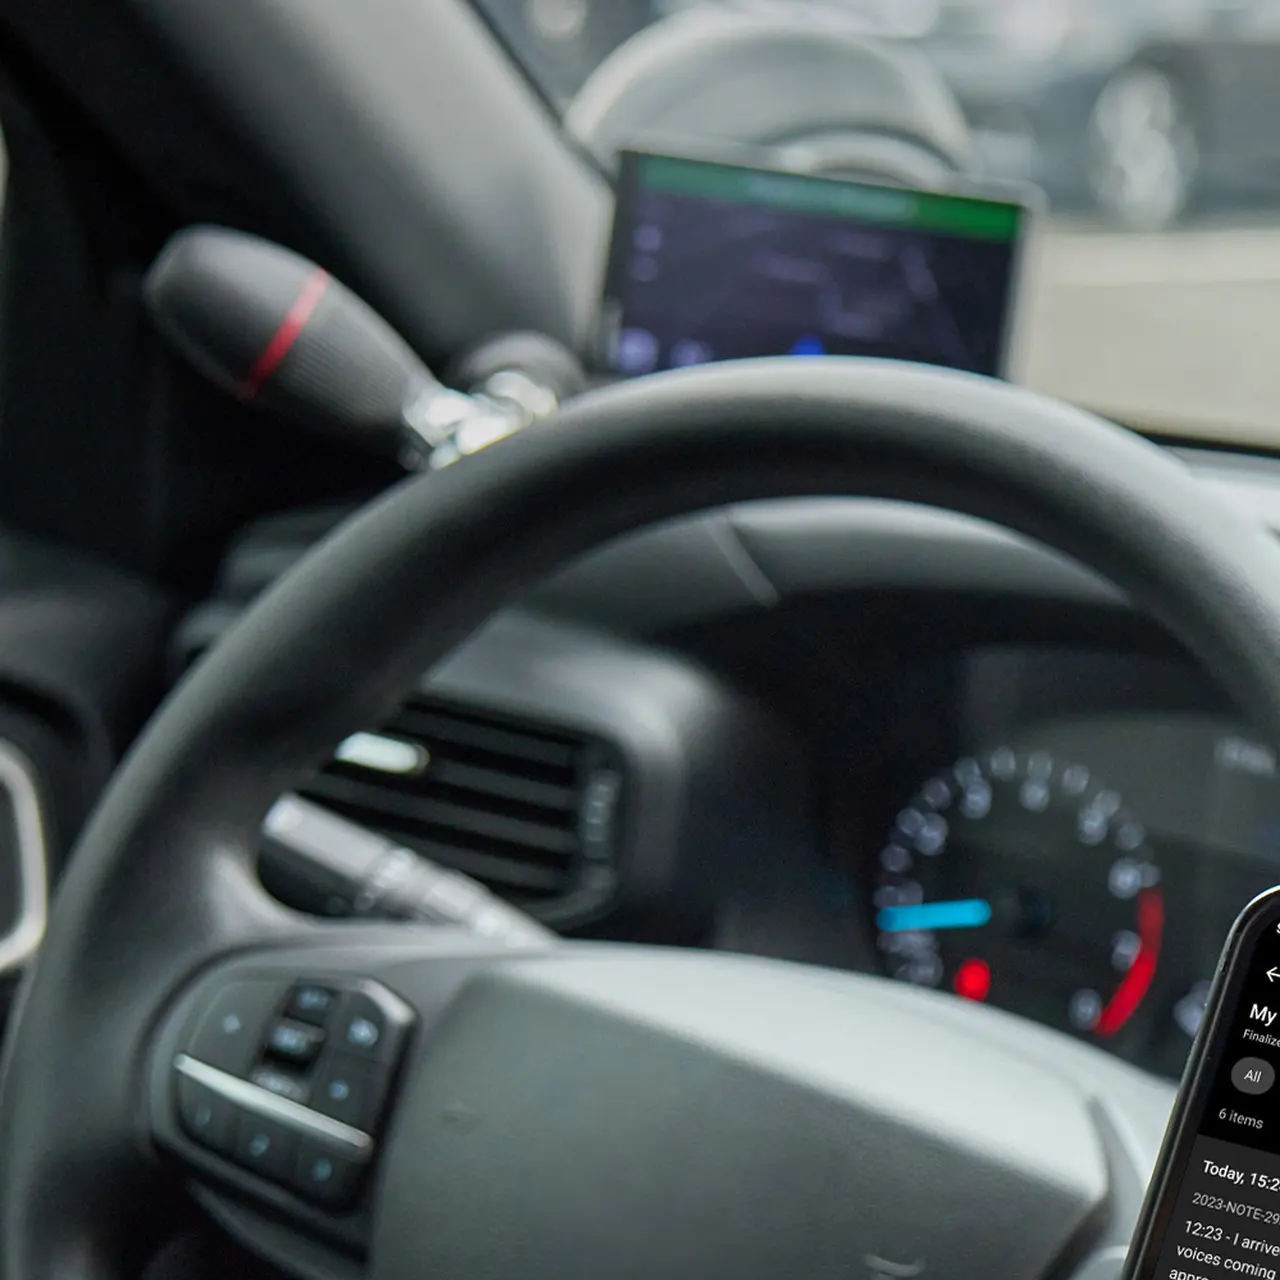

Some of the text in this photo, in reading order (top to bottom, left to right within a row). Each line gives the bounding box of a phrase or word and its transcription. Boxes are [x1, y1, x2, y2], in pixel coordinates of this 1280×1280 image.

[1249, 1003, 1278, 1027] My
[1243, 1069, 1262, 1083] All
[1218, 1107, 1264, 1130] 6 items
[1203, 1159, 1245, 1185] Today,
[1185, 1220, 1223, 1242] 12:23
[1233, 1232, 1240, 1246] I
[1177, 1245, 1221, 1266] voices
